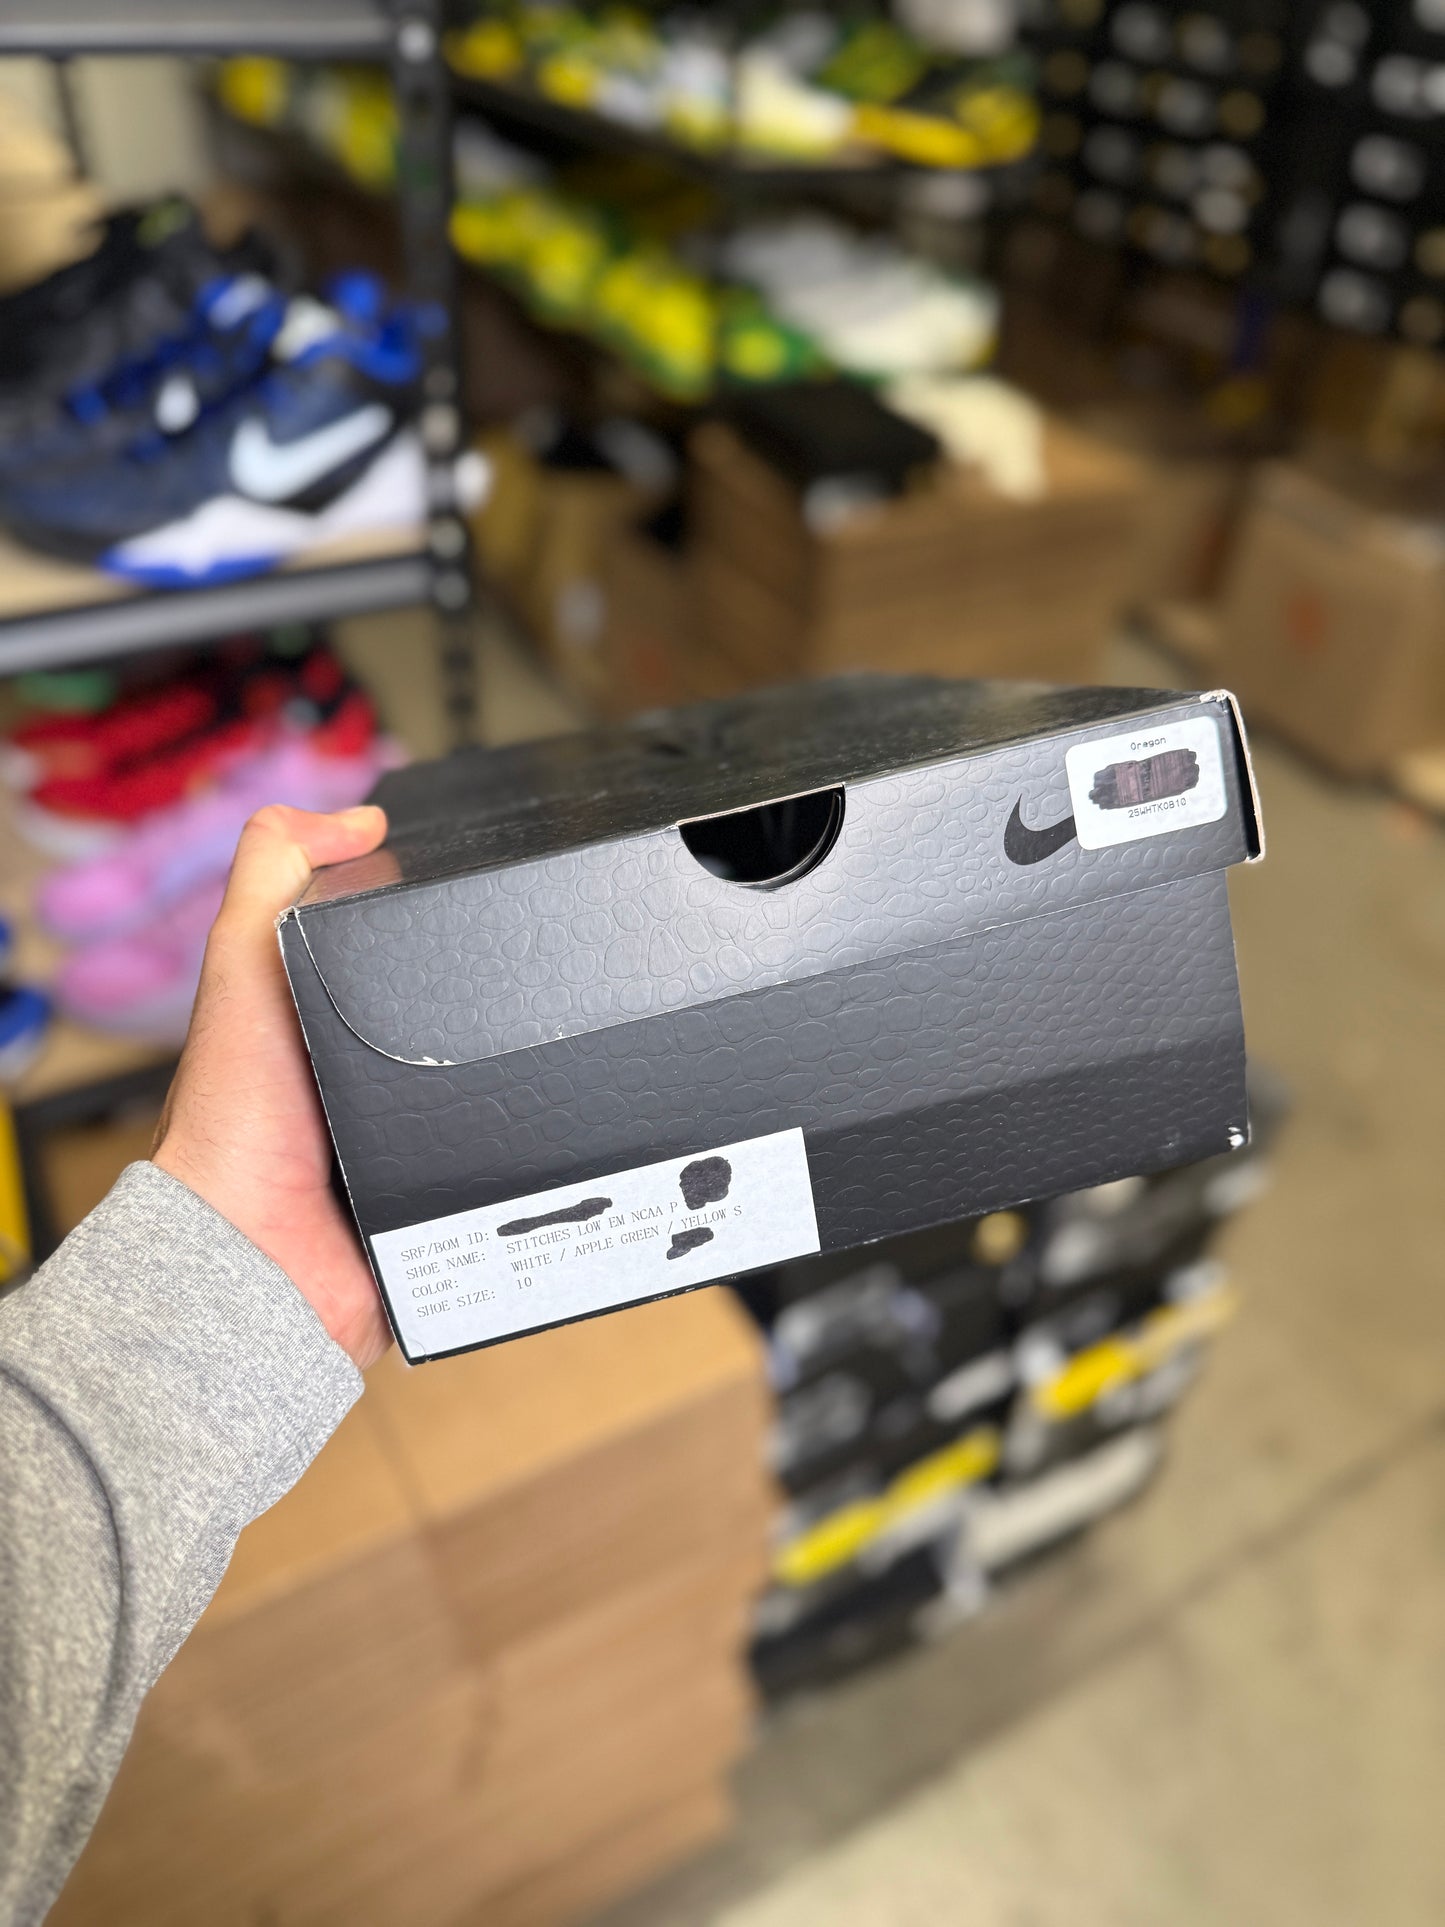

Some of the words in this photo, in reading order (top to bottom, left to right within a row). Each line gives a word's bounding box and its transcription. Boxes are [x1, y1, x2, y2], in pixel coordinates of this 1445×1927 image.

[400, 1237, 460, 1262] SRF/BOM
[466, 1231, 489, 1246] ID:
[406, 1261, 441, 1280] SHOE
[446, 1251, 486, 1270] NAME:
[506, 1228, 571, 1254] STITCHES
[577, 1219, 601, 1236] LOW
[608, 1213, 625, 1228] EM
[631, 1205, 663, 1222] NCAA
[669, 1201, 678, 1213] P
[411, 1279, 459, 1299] COLOR:
[510, 1252, 552, 1272] WHITE
[574, 1237, 614, 1257] APPLE
[620, 1225, 659, 1245] GREEN
[680, 1208, 727, 1229] YELLOW
[733, 1205, 742, 1217] S
[417, 1299, 451, 1318] SHOE
[456, 1289, 496, 1308] SIZE:
[516, 1276, 532, 1290] 10
